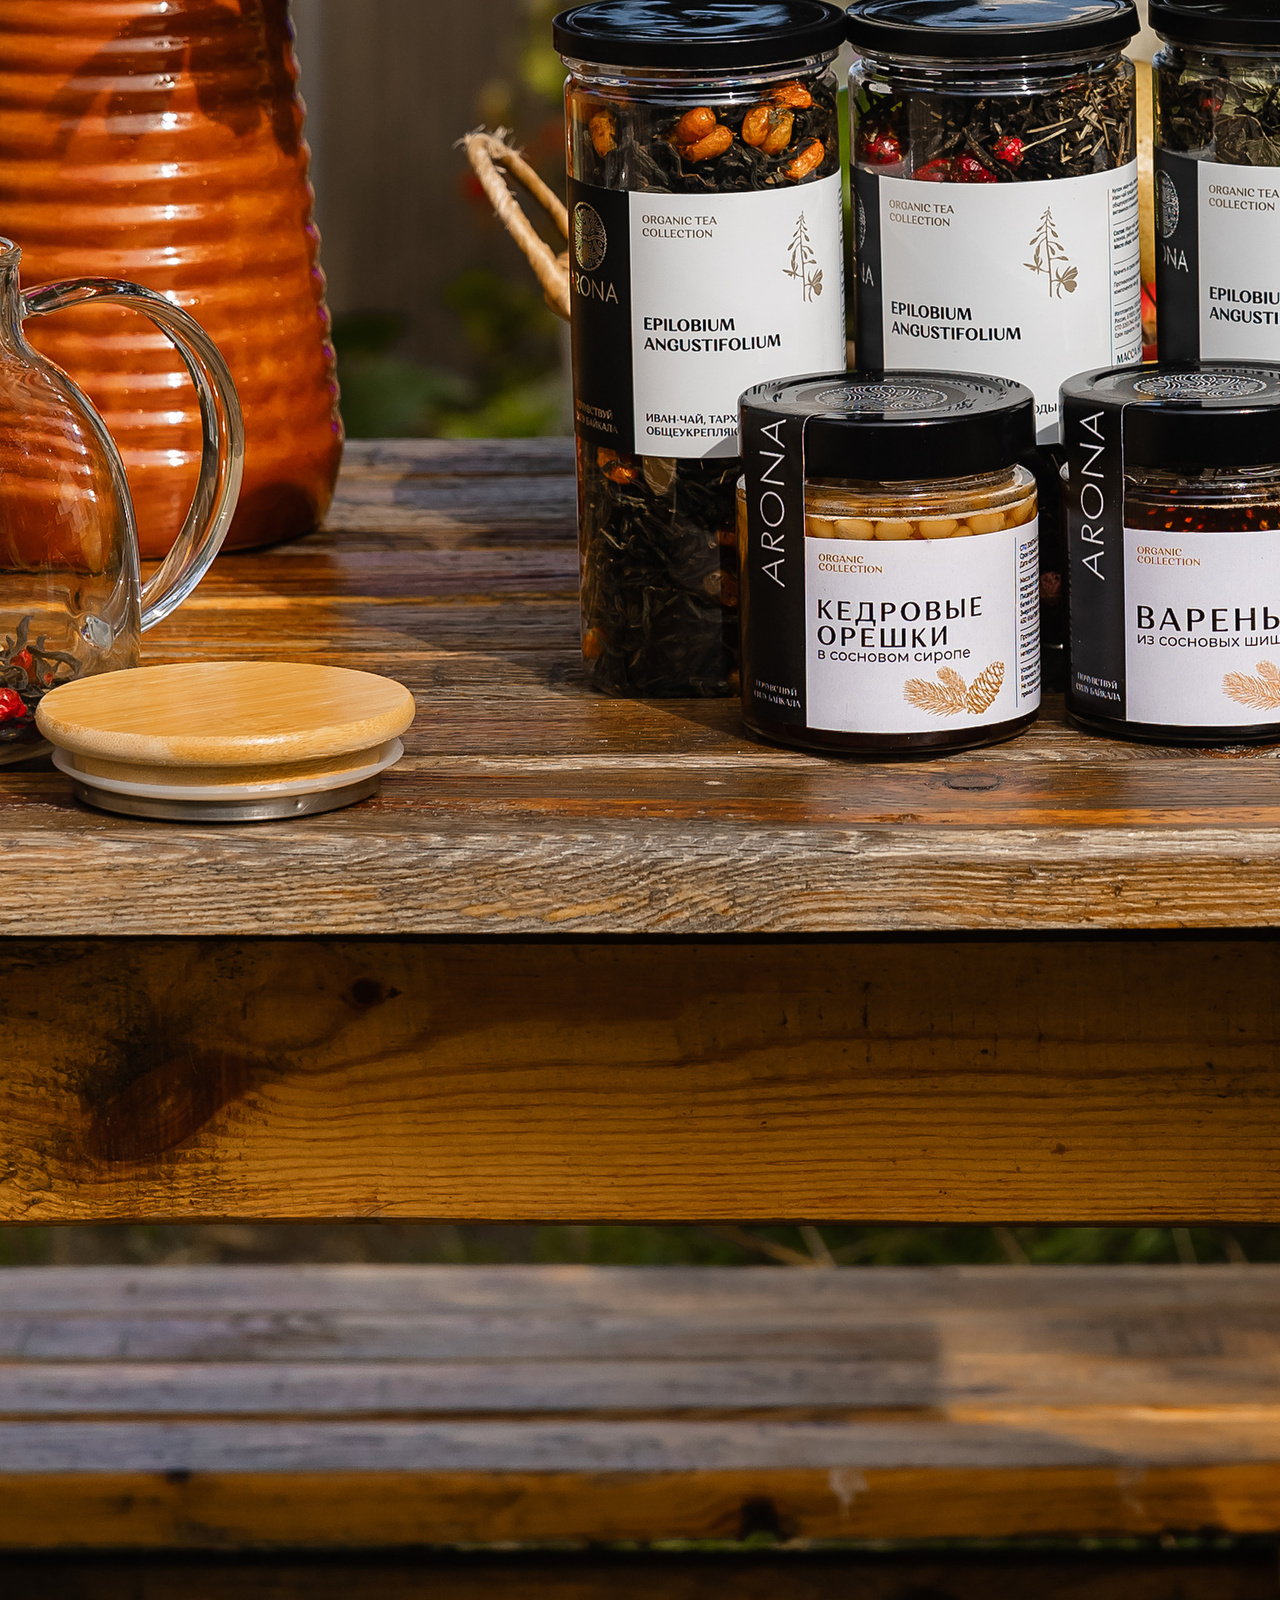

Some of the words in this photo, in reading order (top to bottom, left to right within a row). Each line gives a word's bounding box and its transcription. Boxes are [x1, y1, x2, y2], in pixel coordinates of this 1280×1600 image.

[1209, 185, 1254, 199] ORGANIC
[1258, 189, 1279, 198] TEA
[889, 200, 930, 214] ORGANIC
[933, 204, 954, 214] TEA
[1209, 197, 1274, 210] COLLECTION
[642, 215, 691, 225] ORGANIC
[695, 216, 717, 225] TEA
[890, 211, 952, 226] COLLECTION
[642, 228, 712, 238] COLLECTION
[571, 270, 619, 304] RONA
[892, 301, 972, 322] EPILOBIUM
[644, 317, 735, 331] EPILOBIUM
[892, 321, 1021, 340] ANGUSTIFOLIUM
[644, 334, 780, 351] ANGUSTIFOLIUM
[646, 413, 705, 425] ИВАН-ЧАЙ,
[1079, 410, 1106, 581] ARONA
[760, 418, 787, 588] ARONA
[1137, 546, 1181, 557] ORGANIC
[819, 554, 863, 564] ORGANIC
[1137, 555, 1200, 565] COLLECTION
[819, 563, 882, 573] COLLECTION
[818, 597, 982, 627] КЕДРОВЫЕ
[818, 623, 946, 648] ОРЕШКИ
[1138, 634, 1154, 645] из
[1159, 636, 1239, 647] сосновых
[830, 649, 909, 665] сосновом
[914, 645, 970, 664] сиропе
